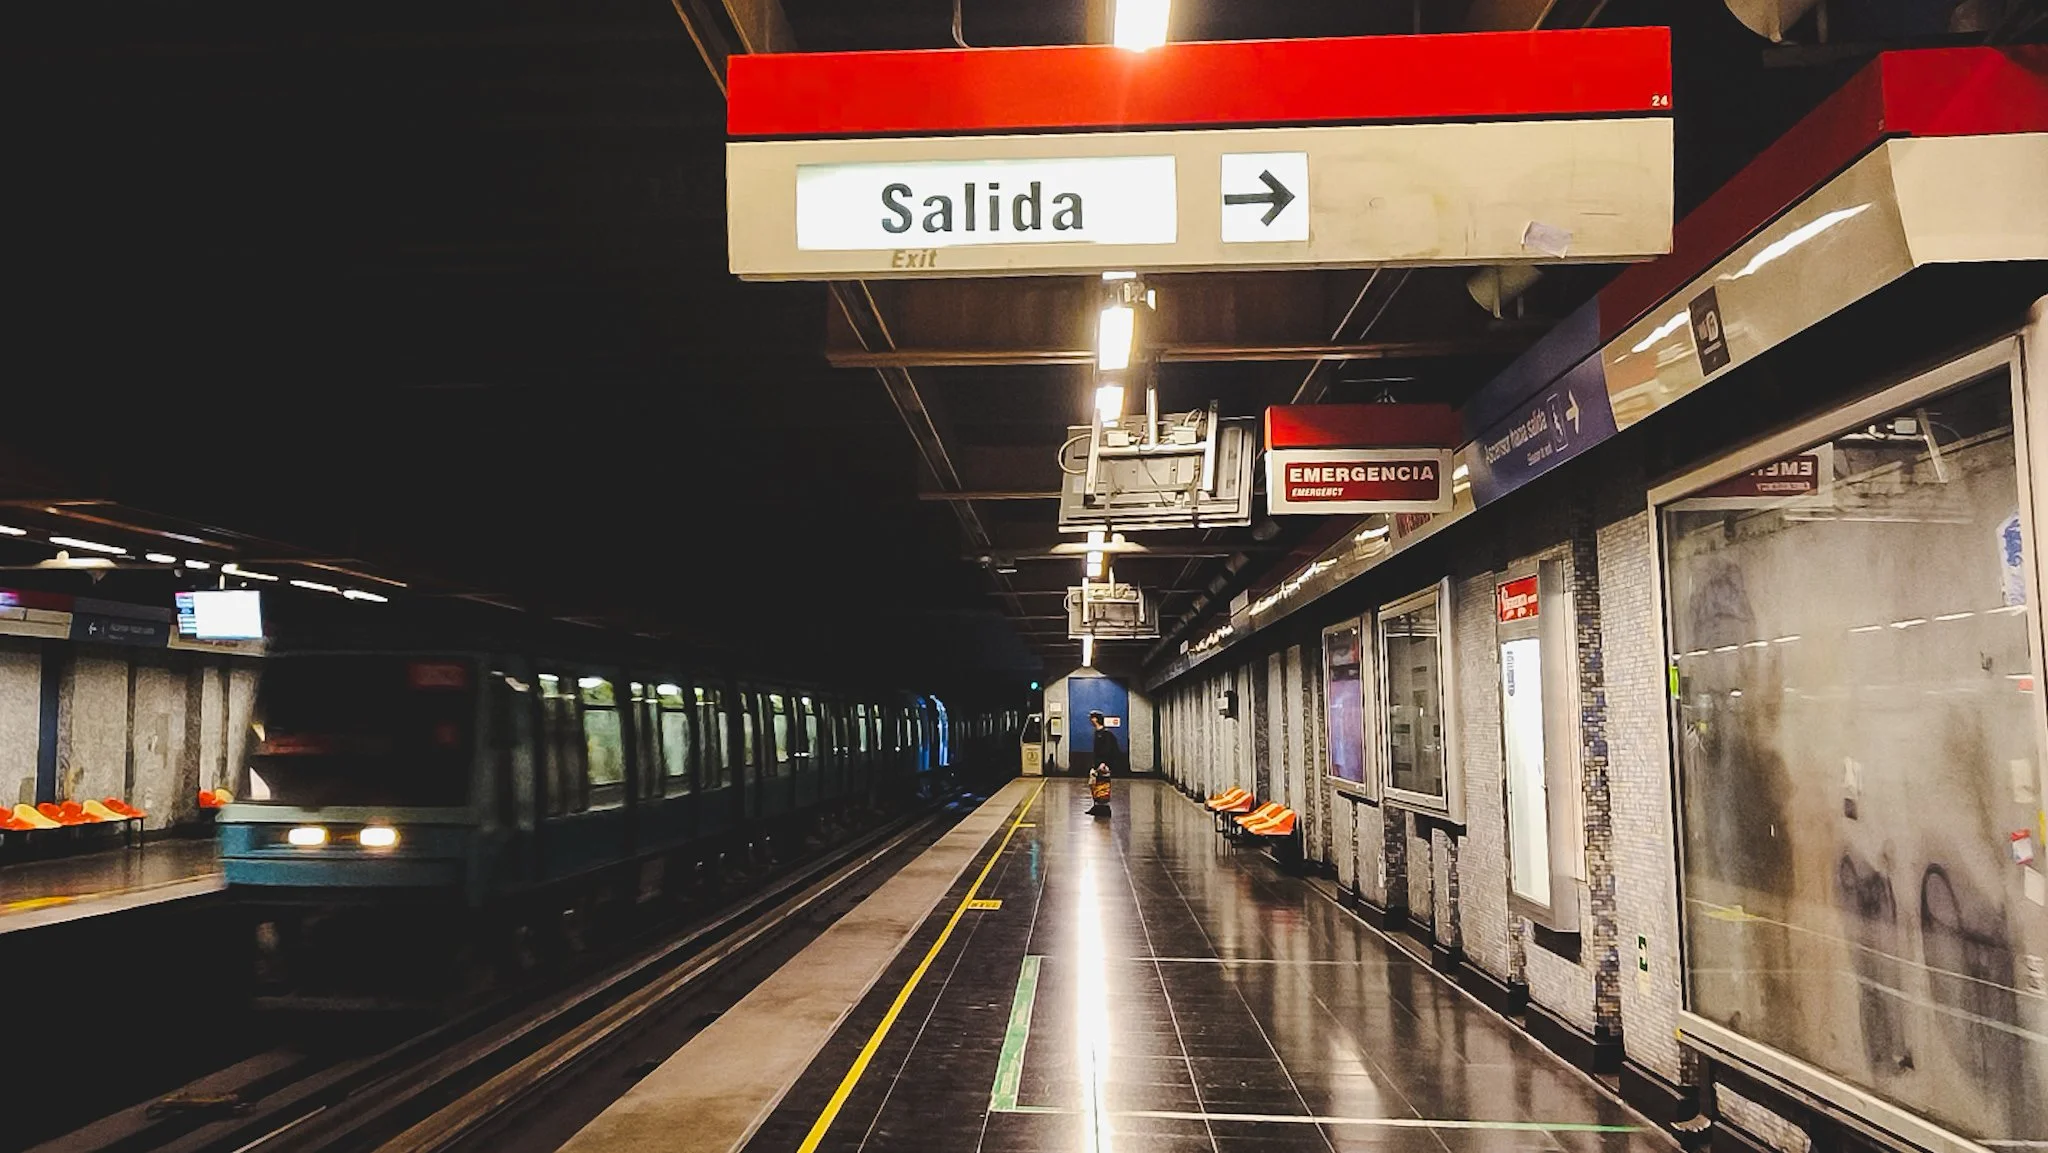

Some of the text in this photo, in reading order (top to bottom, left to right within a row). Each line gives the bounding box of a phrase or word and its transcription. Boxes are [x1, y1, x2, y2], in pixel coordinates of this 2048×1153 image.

[1651, 95, 1669, 106] 24
[881, 181, 1084, 233] Salida
[891, 249, 938, 268] Exit
[1289, 466, 1435, 483] EMERGENCIA
[1291, 487, 1344, 497] EMERGENCY
